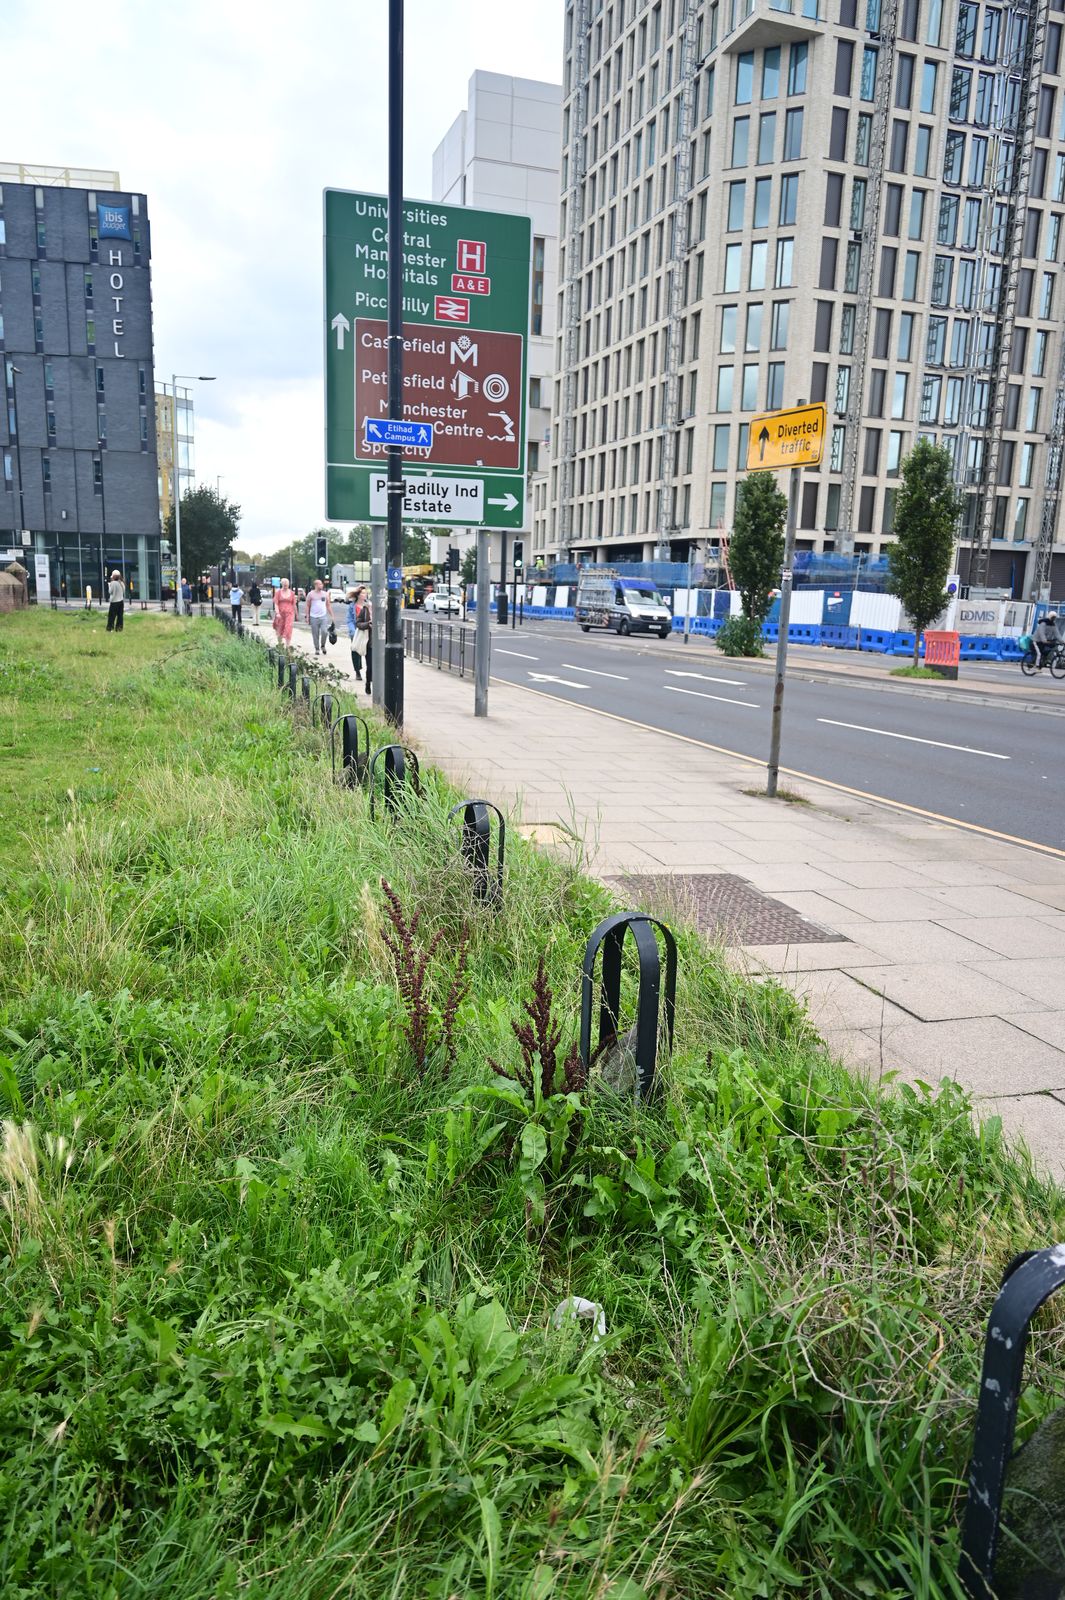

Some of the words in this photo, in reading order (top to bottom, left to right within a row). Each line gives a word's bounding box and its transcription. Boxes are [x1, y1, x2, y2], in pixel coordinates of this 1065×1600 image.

[105, 211, 123, 223] ibis
[355, 200, 448, 227] Univsities
[102, 221, 126, 231] budget
[372, 227, 432, 249] Cetral
[355, 243, 447, 268] Manester
[364, 263, 438, 286] Hoitals
[456, 278, 485, 292] A&E
[109, 249, 125, 358] HOTEL
[355, 291, 430, 316] Piccilly
[361, 333, 446, 355] Casefield
[361, 369, 445, 390] Petsfield
[379, 398, 468, 419] Mnchester
[384, 432, 416, 442] Campus
[387, 424, 413, 434] Etihad
[433, 420, 484, 437] Centre
[778, 419, 818, 437] Diverted
[361, 441, 432, 458] Spocity
[781, 438, 811, 454] traffic
[377, 479, 449, 499] Padilly
[455, 484, 478, 498] Ind
[403, 498, 452, 513] Estate
[960, 610, 995, 622] DOMIS
